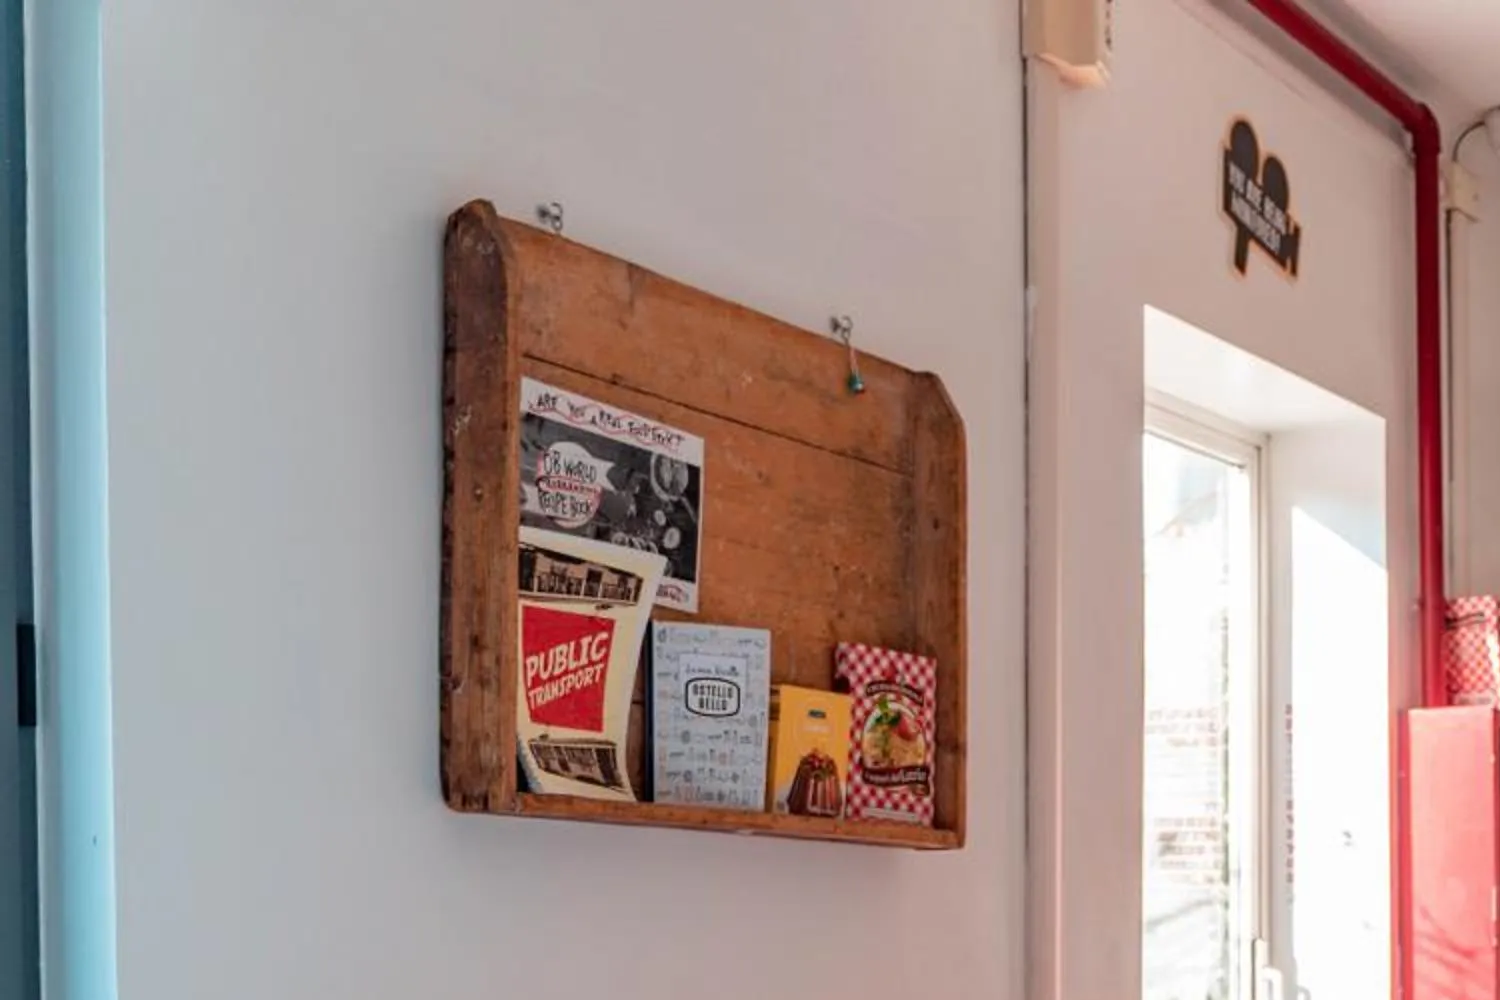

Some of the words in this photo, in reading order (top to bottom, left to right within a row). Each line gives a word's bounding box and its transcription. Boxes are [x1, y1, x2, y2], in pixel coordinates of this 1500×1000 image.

[537, 392, 558, 408] ARE
[544, 450, 561, 475] OB
[563, 458, 597, 483] WORLD
[525, 631, 609, 688] PUBLIC
[528, 664, 606, 711] TRANSPORT
[693, 684, 733, 699] OSTELLO
[699, 698, 727, 711] BELLO
